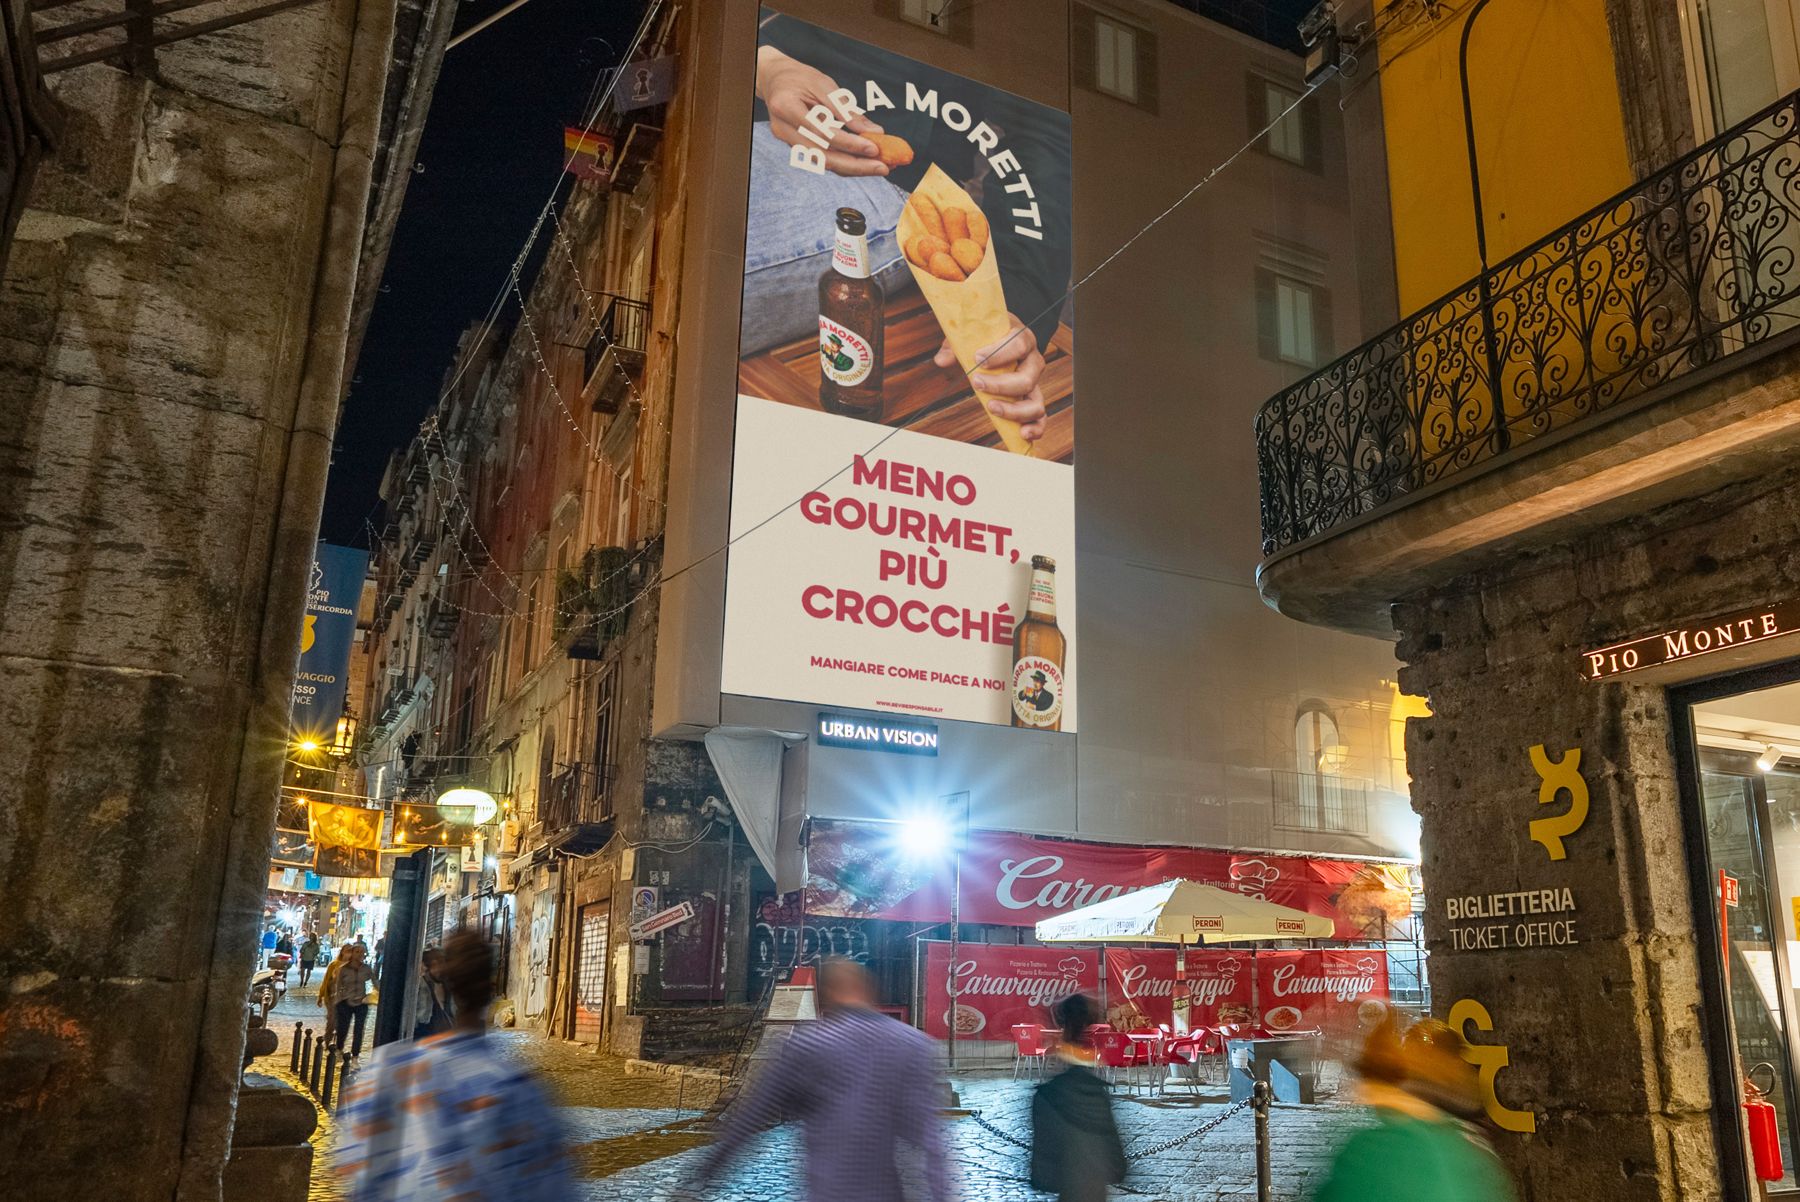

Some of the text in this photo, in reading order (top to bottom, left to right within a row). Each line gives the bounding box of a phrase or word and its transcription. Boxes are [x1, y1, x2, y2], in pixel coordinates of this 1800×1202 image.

[789, 80, 1043, 241] BIRRA MORETTI
[829, 323, 869, 362] MORETTI
[853, 453, 977, 506] MENO
[800, 491, 1020, 565] GOURMET,
[879, 545, 947, 590] PIÙ
[308, 594, 329, 602] ONTE
[316, 589, 330, 597] PIO
[306, 604, 353, 616] ISERICORDIA
[801, 584, 1015, 646] CROCCHÉ
[1590, 613, 1778, 677] PIO MONTE
[294, 684, 317, 695] SSO
[297, 672, 336, 684] VAGGIO
[810, 656, 1006, 691] MANGIARE COME PIACE A NOI
[1013, 661, 1032, 688] BIRRA
[293, 695, 313, 706] NCE
[821, 721, 937, 747] URBAN VISION
[1446, 887, 1577, 920] BIGLIETTERIA
[1195, 918, 1222, 928] PERONI
[1278, 921, 1304, 931] PERONI
[1449, 920, 1579, 950] TICKET OFFICE
[946, 960, 1081, 1006] Caravaggio
[1122, 965, 1237, 1006] Caraaggio
[1273, 964, 1376, 1002] Caravaggio
